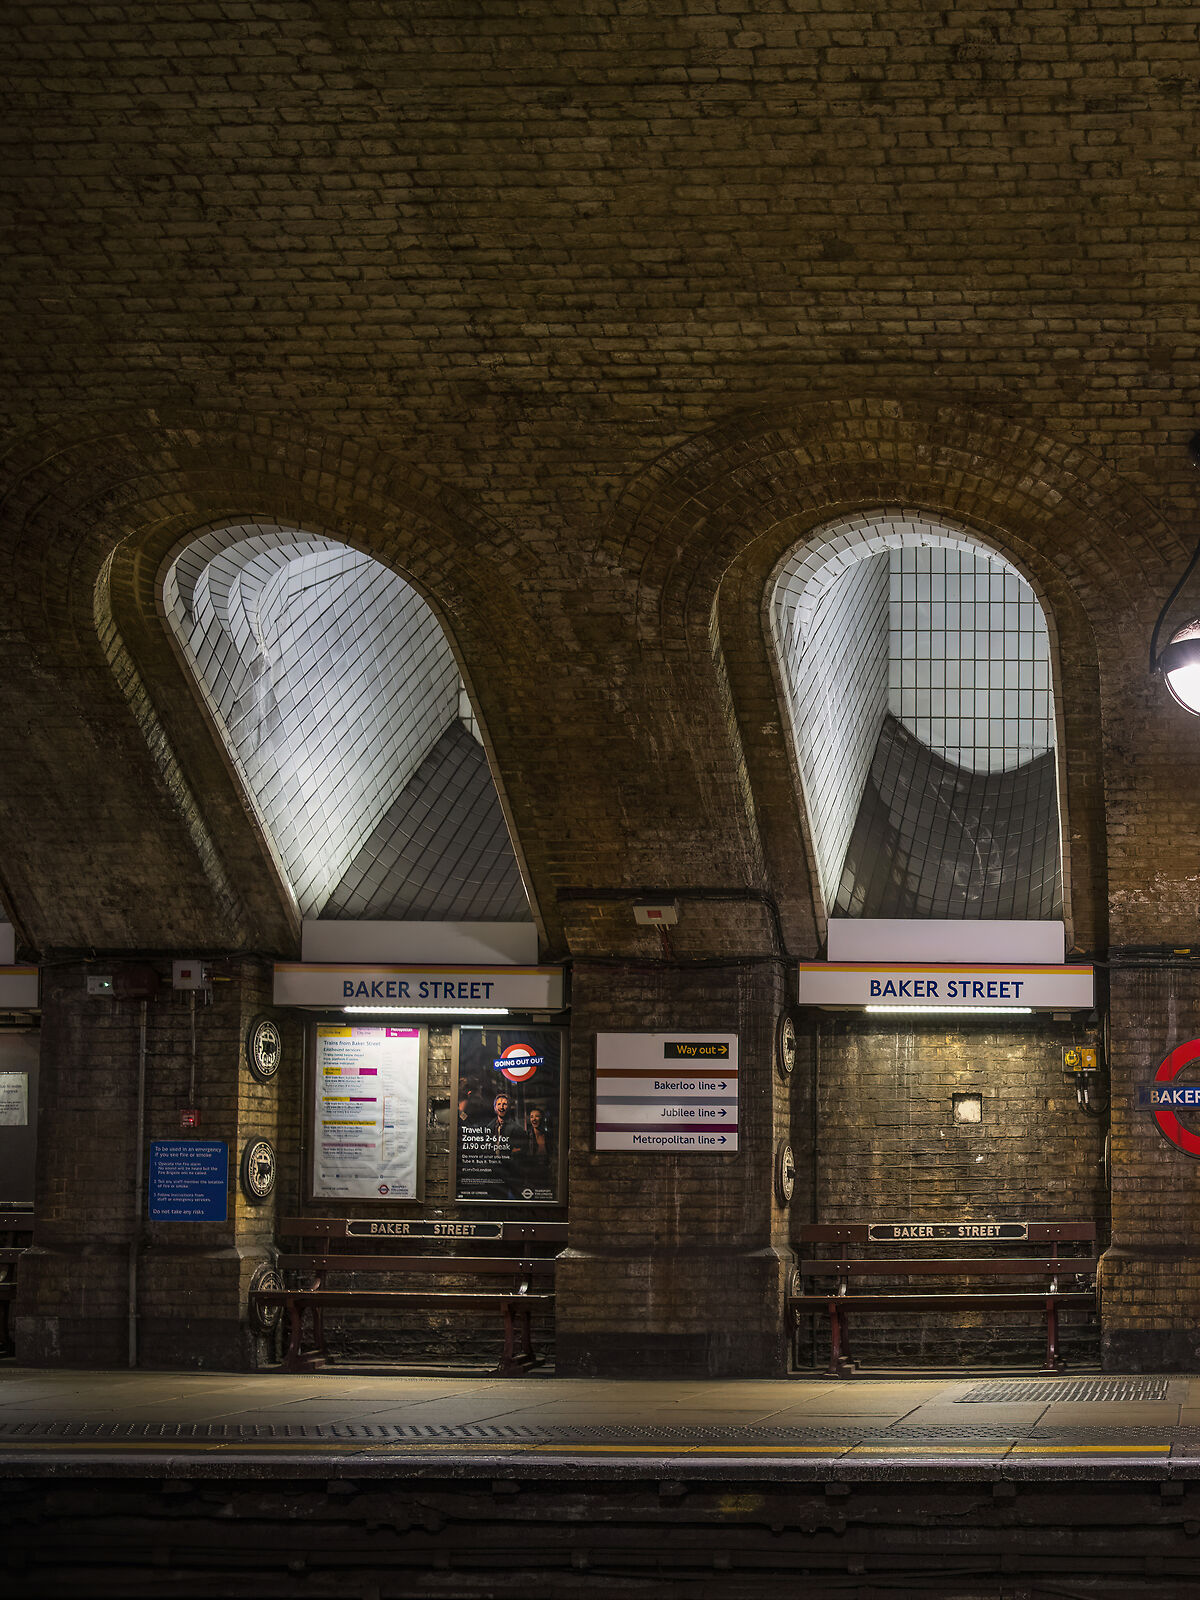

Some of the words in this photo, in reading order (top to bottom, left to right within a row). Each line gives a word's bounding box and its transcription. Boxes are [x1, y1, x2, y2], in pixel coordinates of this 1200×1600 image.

[343, 981, 410, 998] BAKER
[418, 981, 494, 999] STREET
[870, 980, 939, 998] BAKER
[946, 981, 1024, 998] STREET
[676, 1045, 697, 1056] Way
[699, 1045, 716, 1054] out
[654, 1081, 695, 1090] Bakerloo
[698, 1081, 716, 1090] line
[661, 1108, 695, 1117] Jubilee
[698, 1108, 716, 1117] line
[462, 1126, 483, 1134] Travel
[633, 1136, 695, 1145] Metropolitan
[698, 1136, 715, 1144] line
[480, 1143, 511, 1151] off-peak
[370, 1223, 410, 1234] BAKER
[433, 1224, 476, 1235] STREET
[893, 1227, 934, 1237] BAKER
[958, 1226, 1001, 1237] STREET
